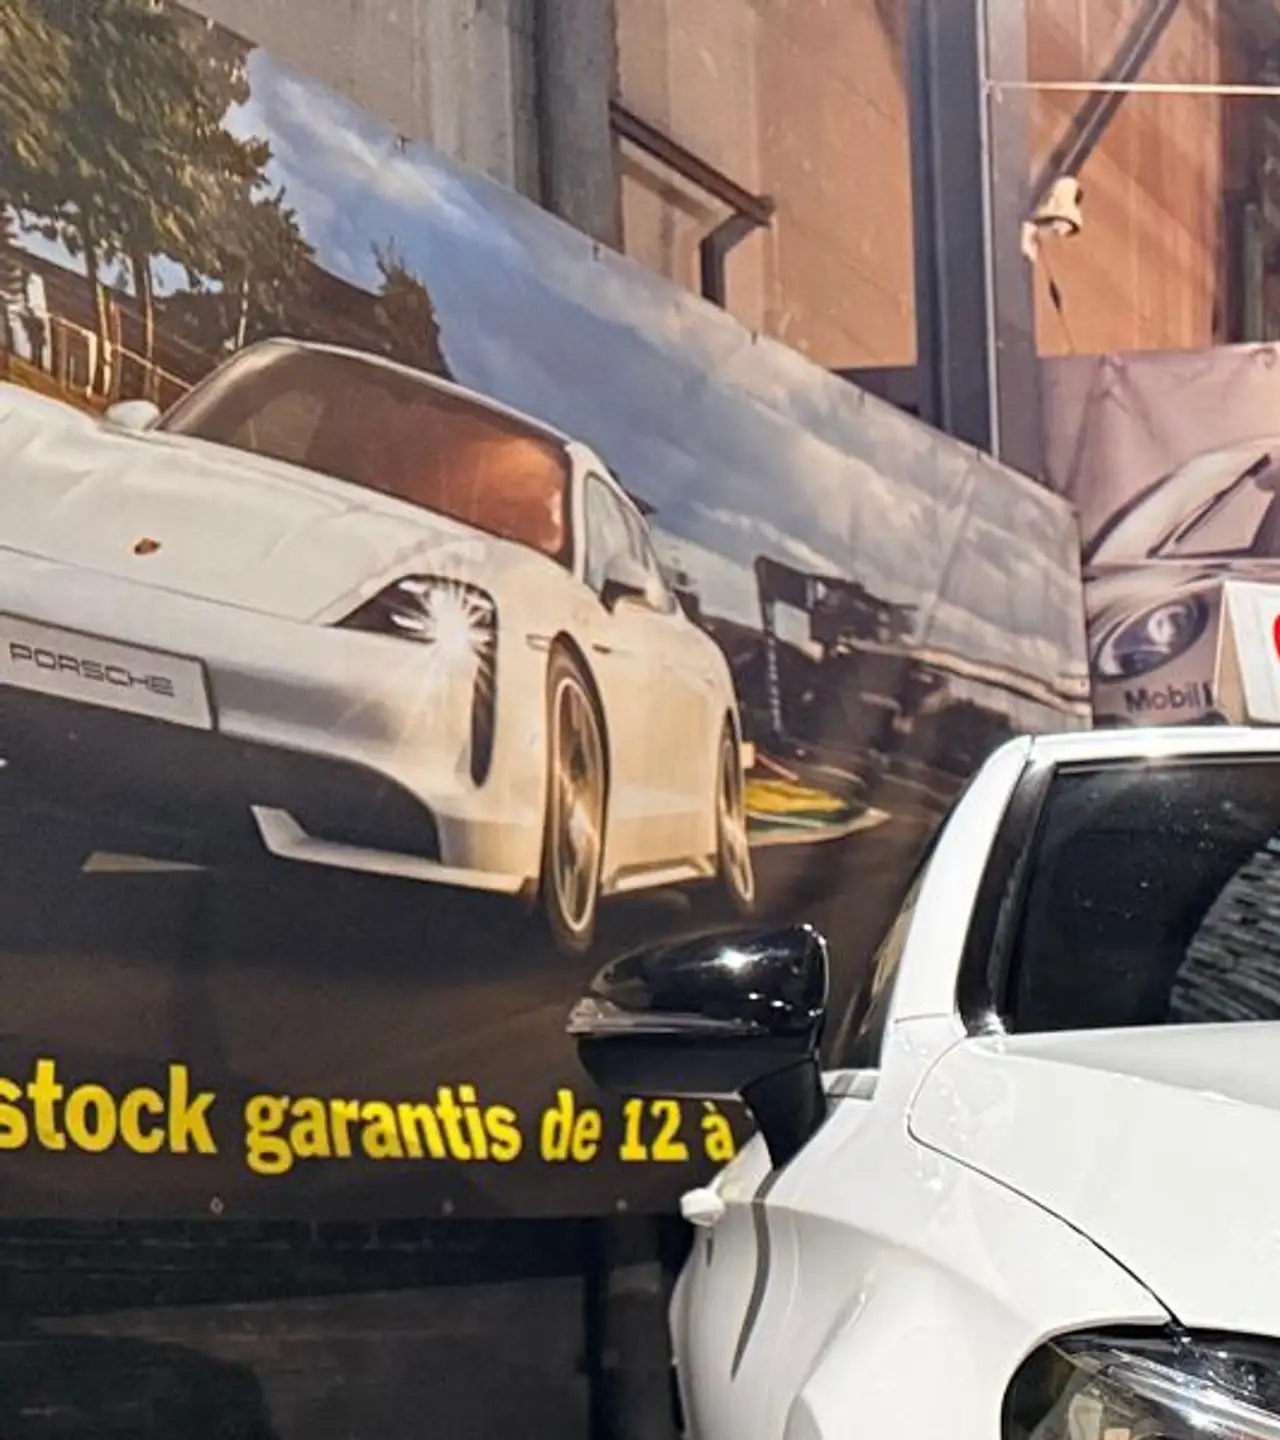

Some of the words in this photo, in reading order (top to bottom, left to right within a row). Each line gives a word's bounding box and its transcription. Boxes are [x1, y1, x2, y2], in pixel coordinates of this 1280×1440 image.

[9, 642, 175, 697] PORSCHE
[0, 1057, 217, 1155] stock
[243, 1084, 521, 1175] garantis
[540, 1088, 602, 1163] de
[620, 1098, 690, 1163] 12
[704, 1099, 735, 1162] à
